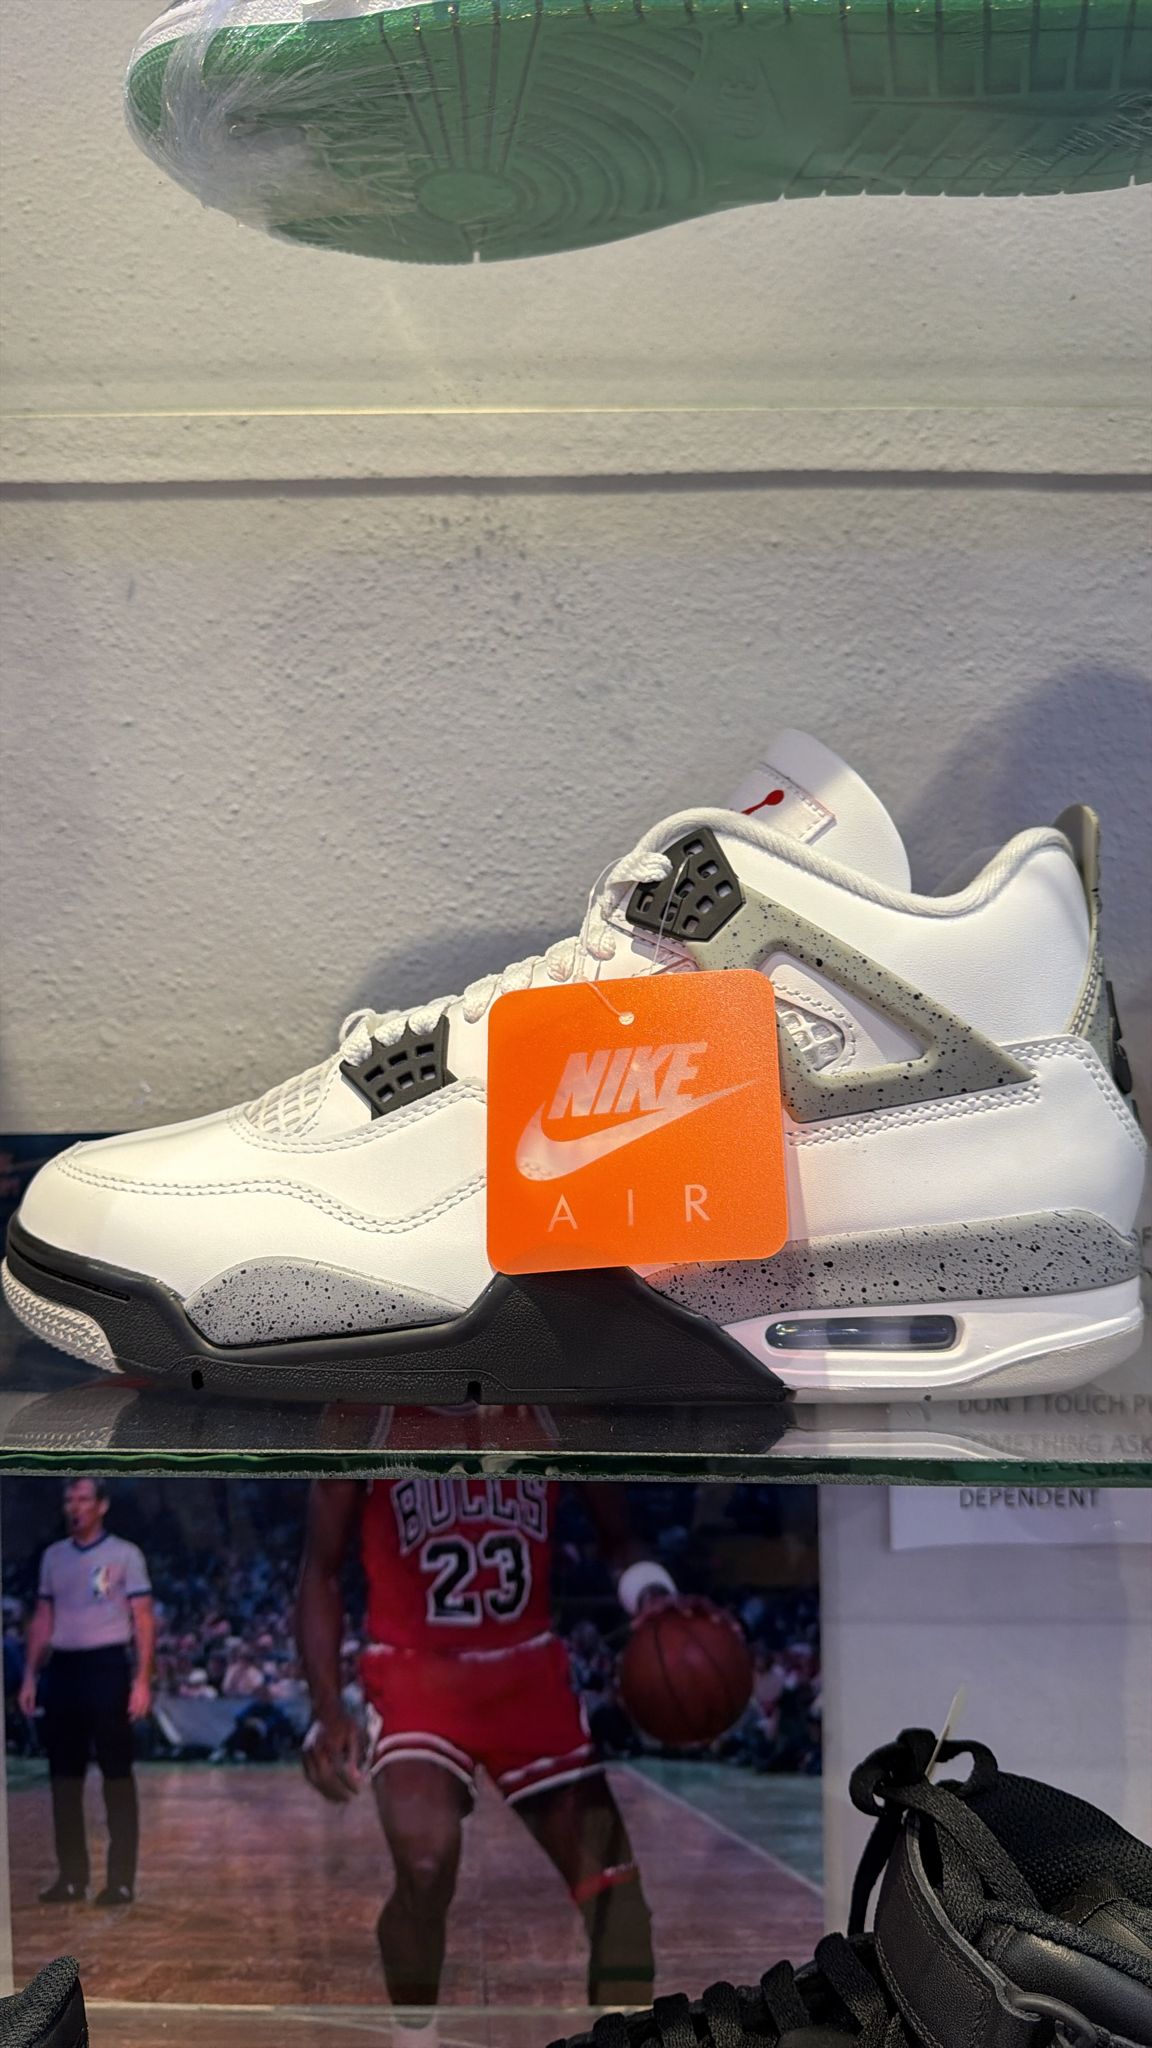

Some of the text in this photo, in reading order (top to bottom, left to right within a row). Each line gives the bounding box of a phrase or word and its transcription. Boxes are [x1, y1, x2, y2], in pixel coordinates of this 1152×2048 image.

[547, 1042, 708, 1120] NIKE
[548, 1184, 711, 1232] AIR
[958, 1393, 1152, 1416] DONT TOUCH P
[391, 1480, 549, 1557] BULLS
[959, 1488, 1099, 1509] DEPENDENT
[420, 1528, 533, 1627] 23
